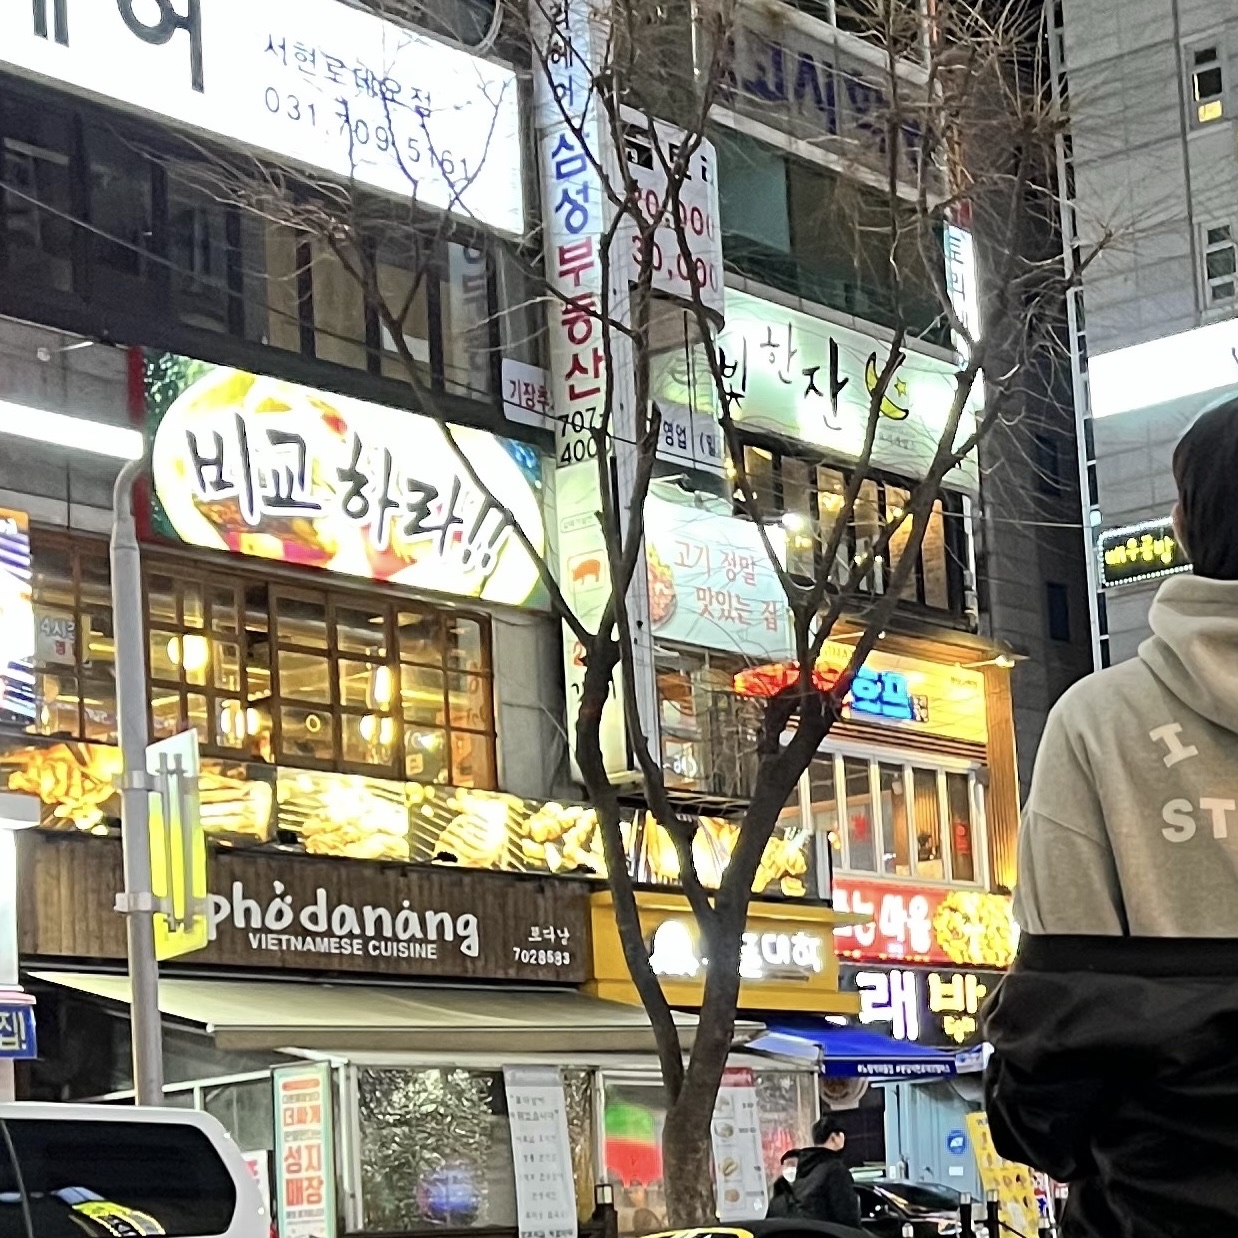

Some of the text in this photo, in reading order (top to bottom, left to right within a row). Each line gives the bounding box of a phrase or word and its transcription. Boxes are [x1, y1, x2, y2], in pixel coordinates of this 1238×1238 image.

[185, 412, 513, 569] 비교하라!!
[673, 540, 758, 587] 고기 정말
[695, 586, 779, 633] 맛있는 집
[248, 932, 438, 960] VIETNAMESE CUISINE
[283, 1145, 322, 1175] 성지
